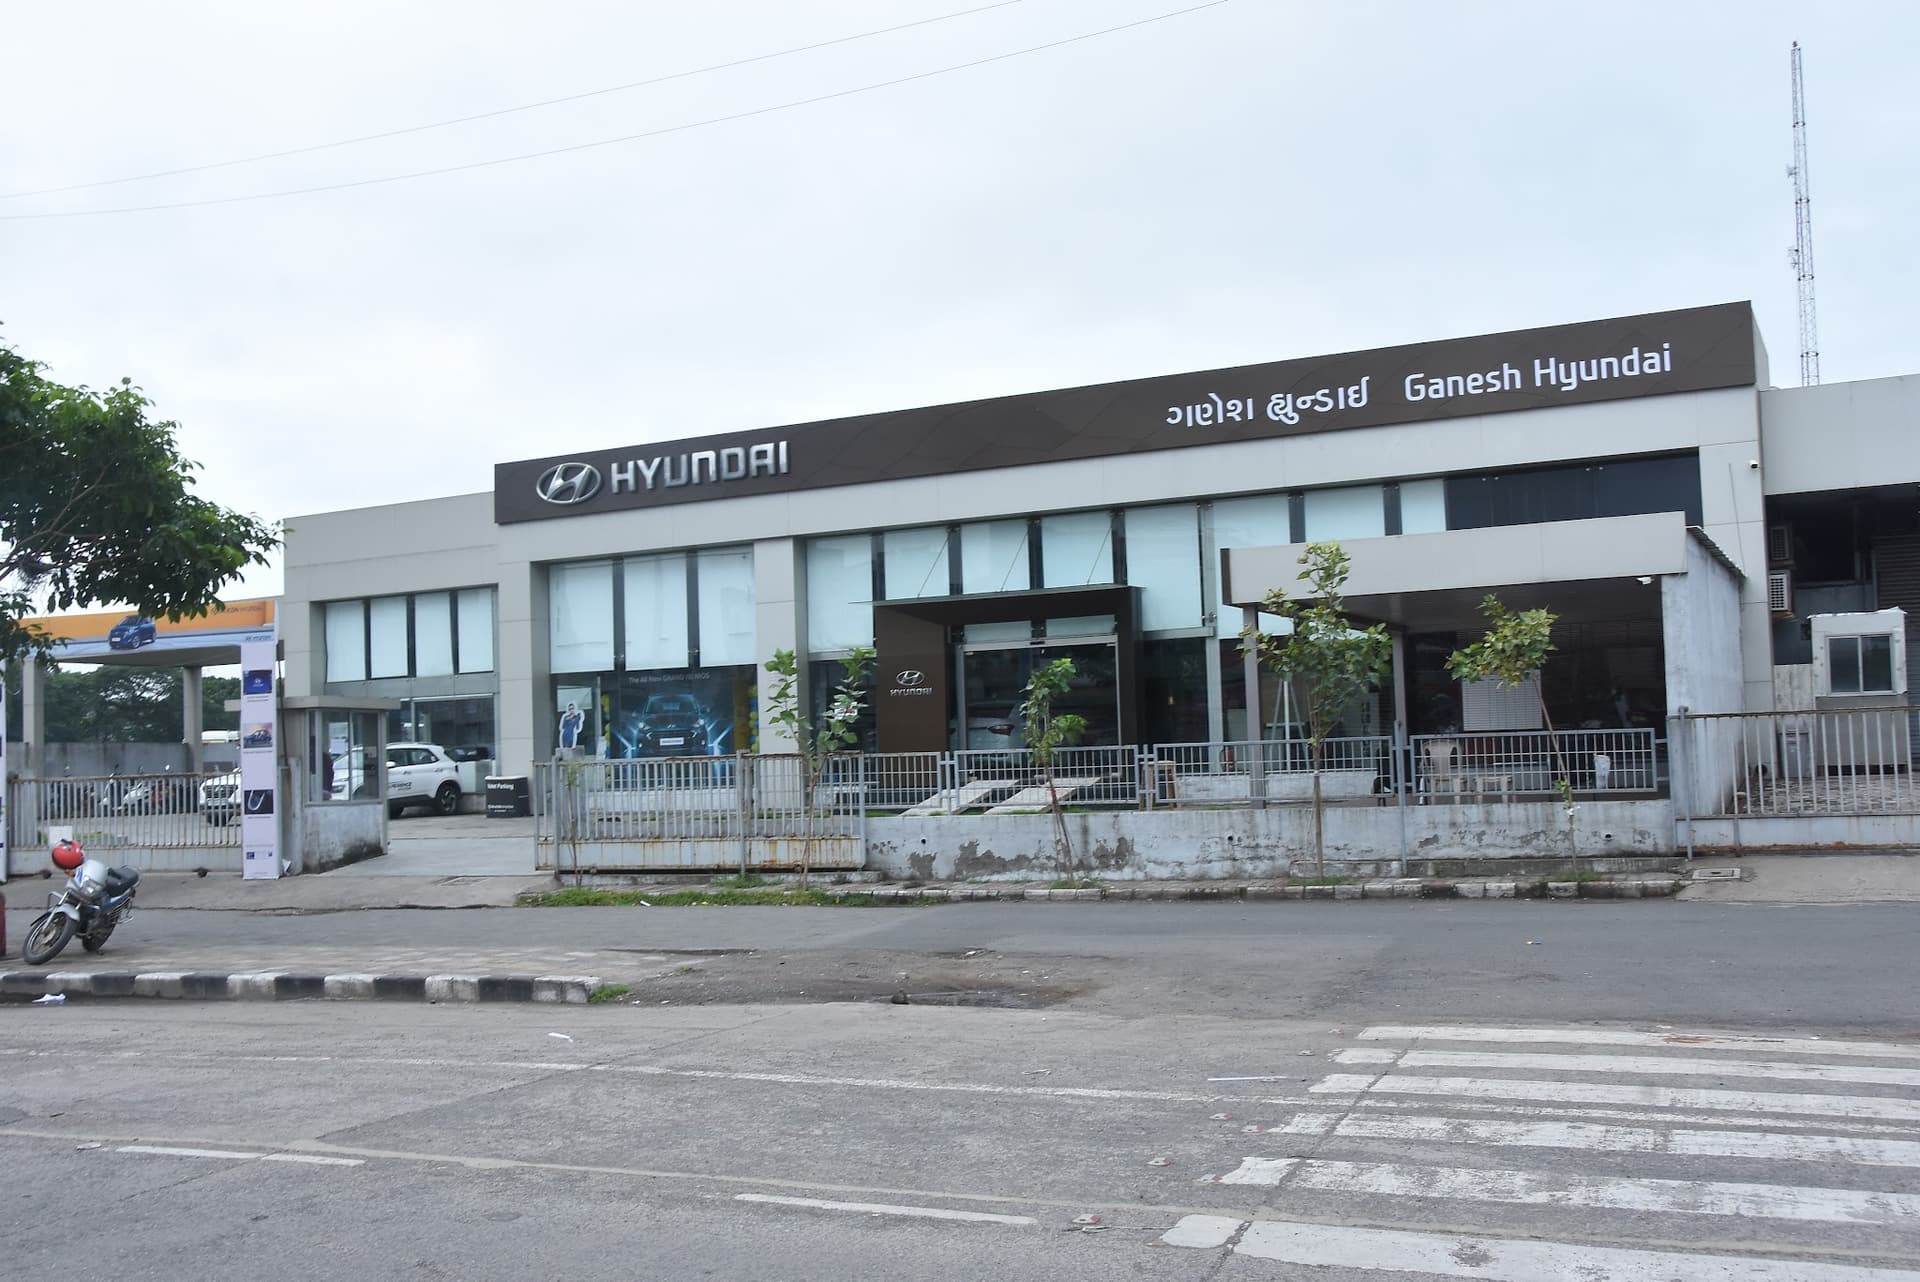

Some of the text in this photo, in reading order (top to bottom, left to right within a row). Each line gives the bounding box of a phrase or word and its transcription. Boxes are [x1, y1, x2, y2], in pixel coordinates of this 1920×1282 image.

[1404, 343, 1672, 401] Ganesh Hyundai
[1166, 392, 1254, 428] ગણેશ
[611, 440, 788, 494] HYUNDAI
[890, 687, 932, 697] HYUNDAI
